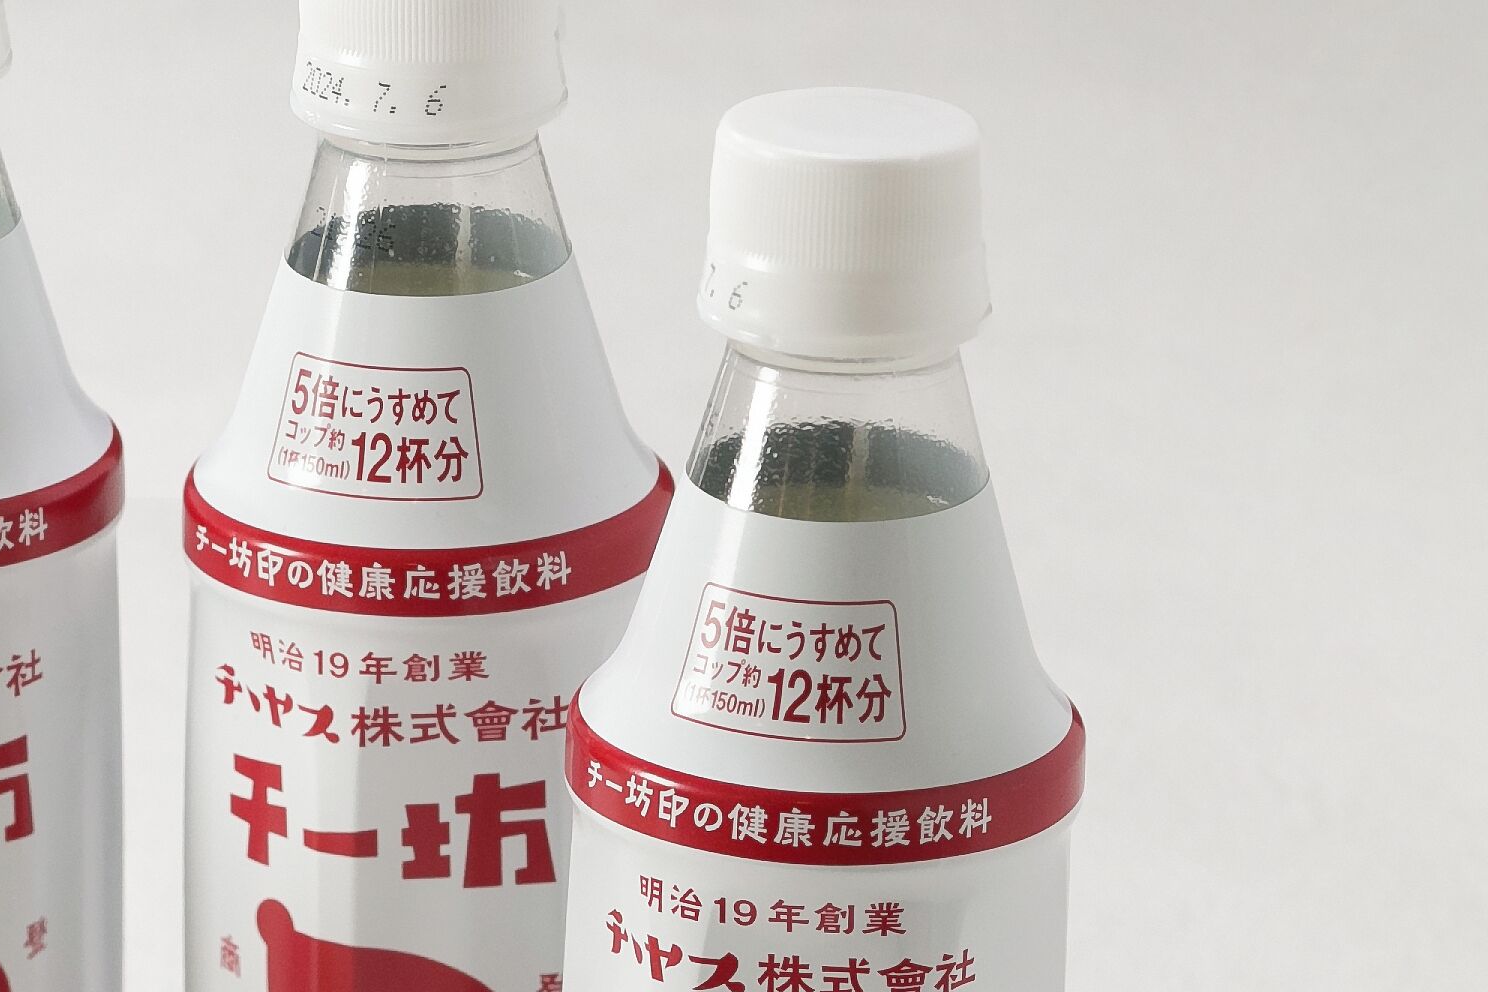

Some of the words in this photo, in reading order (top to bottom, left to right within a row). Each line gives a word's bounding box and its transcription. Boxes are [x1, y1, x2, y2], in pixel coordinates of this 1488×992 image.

[425, 85, 447, 116] 6
[291, 368, 460, 425] 5倍にうすめて
[285, 419, 345, 451] コップ約
[351, 432, 469, 483] 12杯分
[195, 524, 571, 601] チー坊印の健康応援飲料
[249, 631, 489, 684] 明治19年創業
[701, 600, 885, 663] 5倍にうすめて
[693, 653, 762, 688] コップ約
[767, 668, 892, 725] 12杯分
[229, 753, 556, 889] チー坊
[587, 760, 993, 848] チー坊印の健康応援飲料
[639, 874, 907, 936] 明治19年創業
